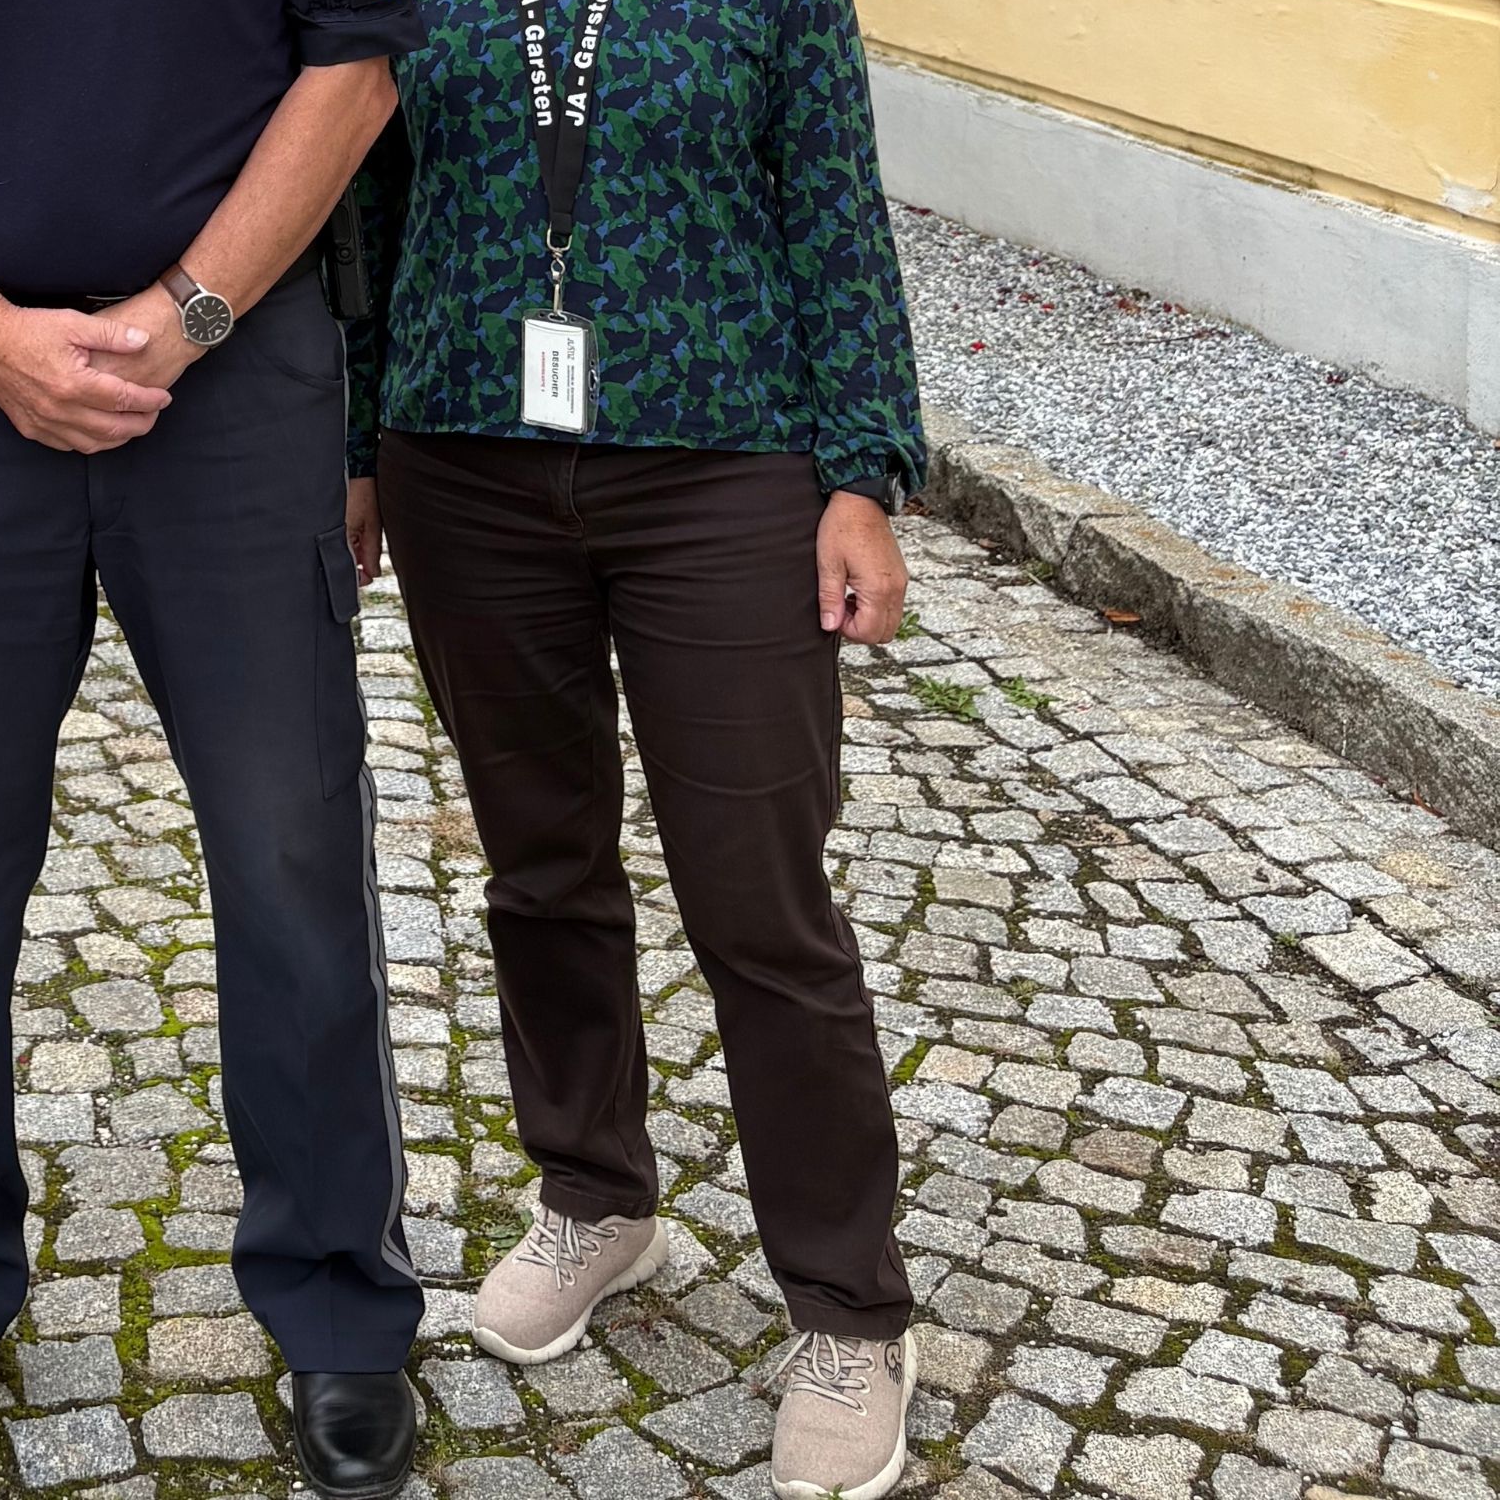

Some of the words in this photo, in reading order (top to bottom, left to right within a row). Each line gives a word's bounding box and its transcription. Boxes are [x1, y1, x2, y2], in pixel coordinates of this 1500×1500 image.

[527, 9, 535, 19] -
[524, 24, 553, 127] Garsten
[565, 92, 587, 127] JA
[577, 76, 585, 87] -
[551, 350, 559, 398] BESUCHER
